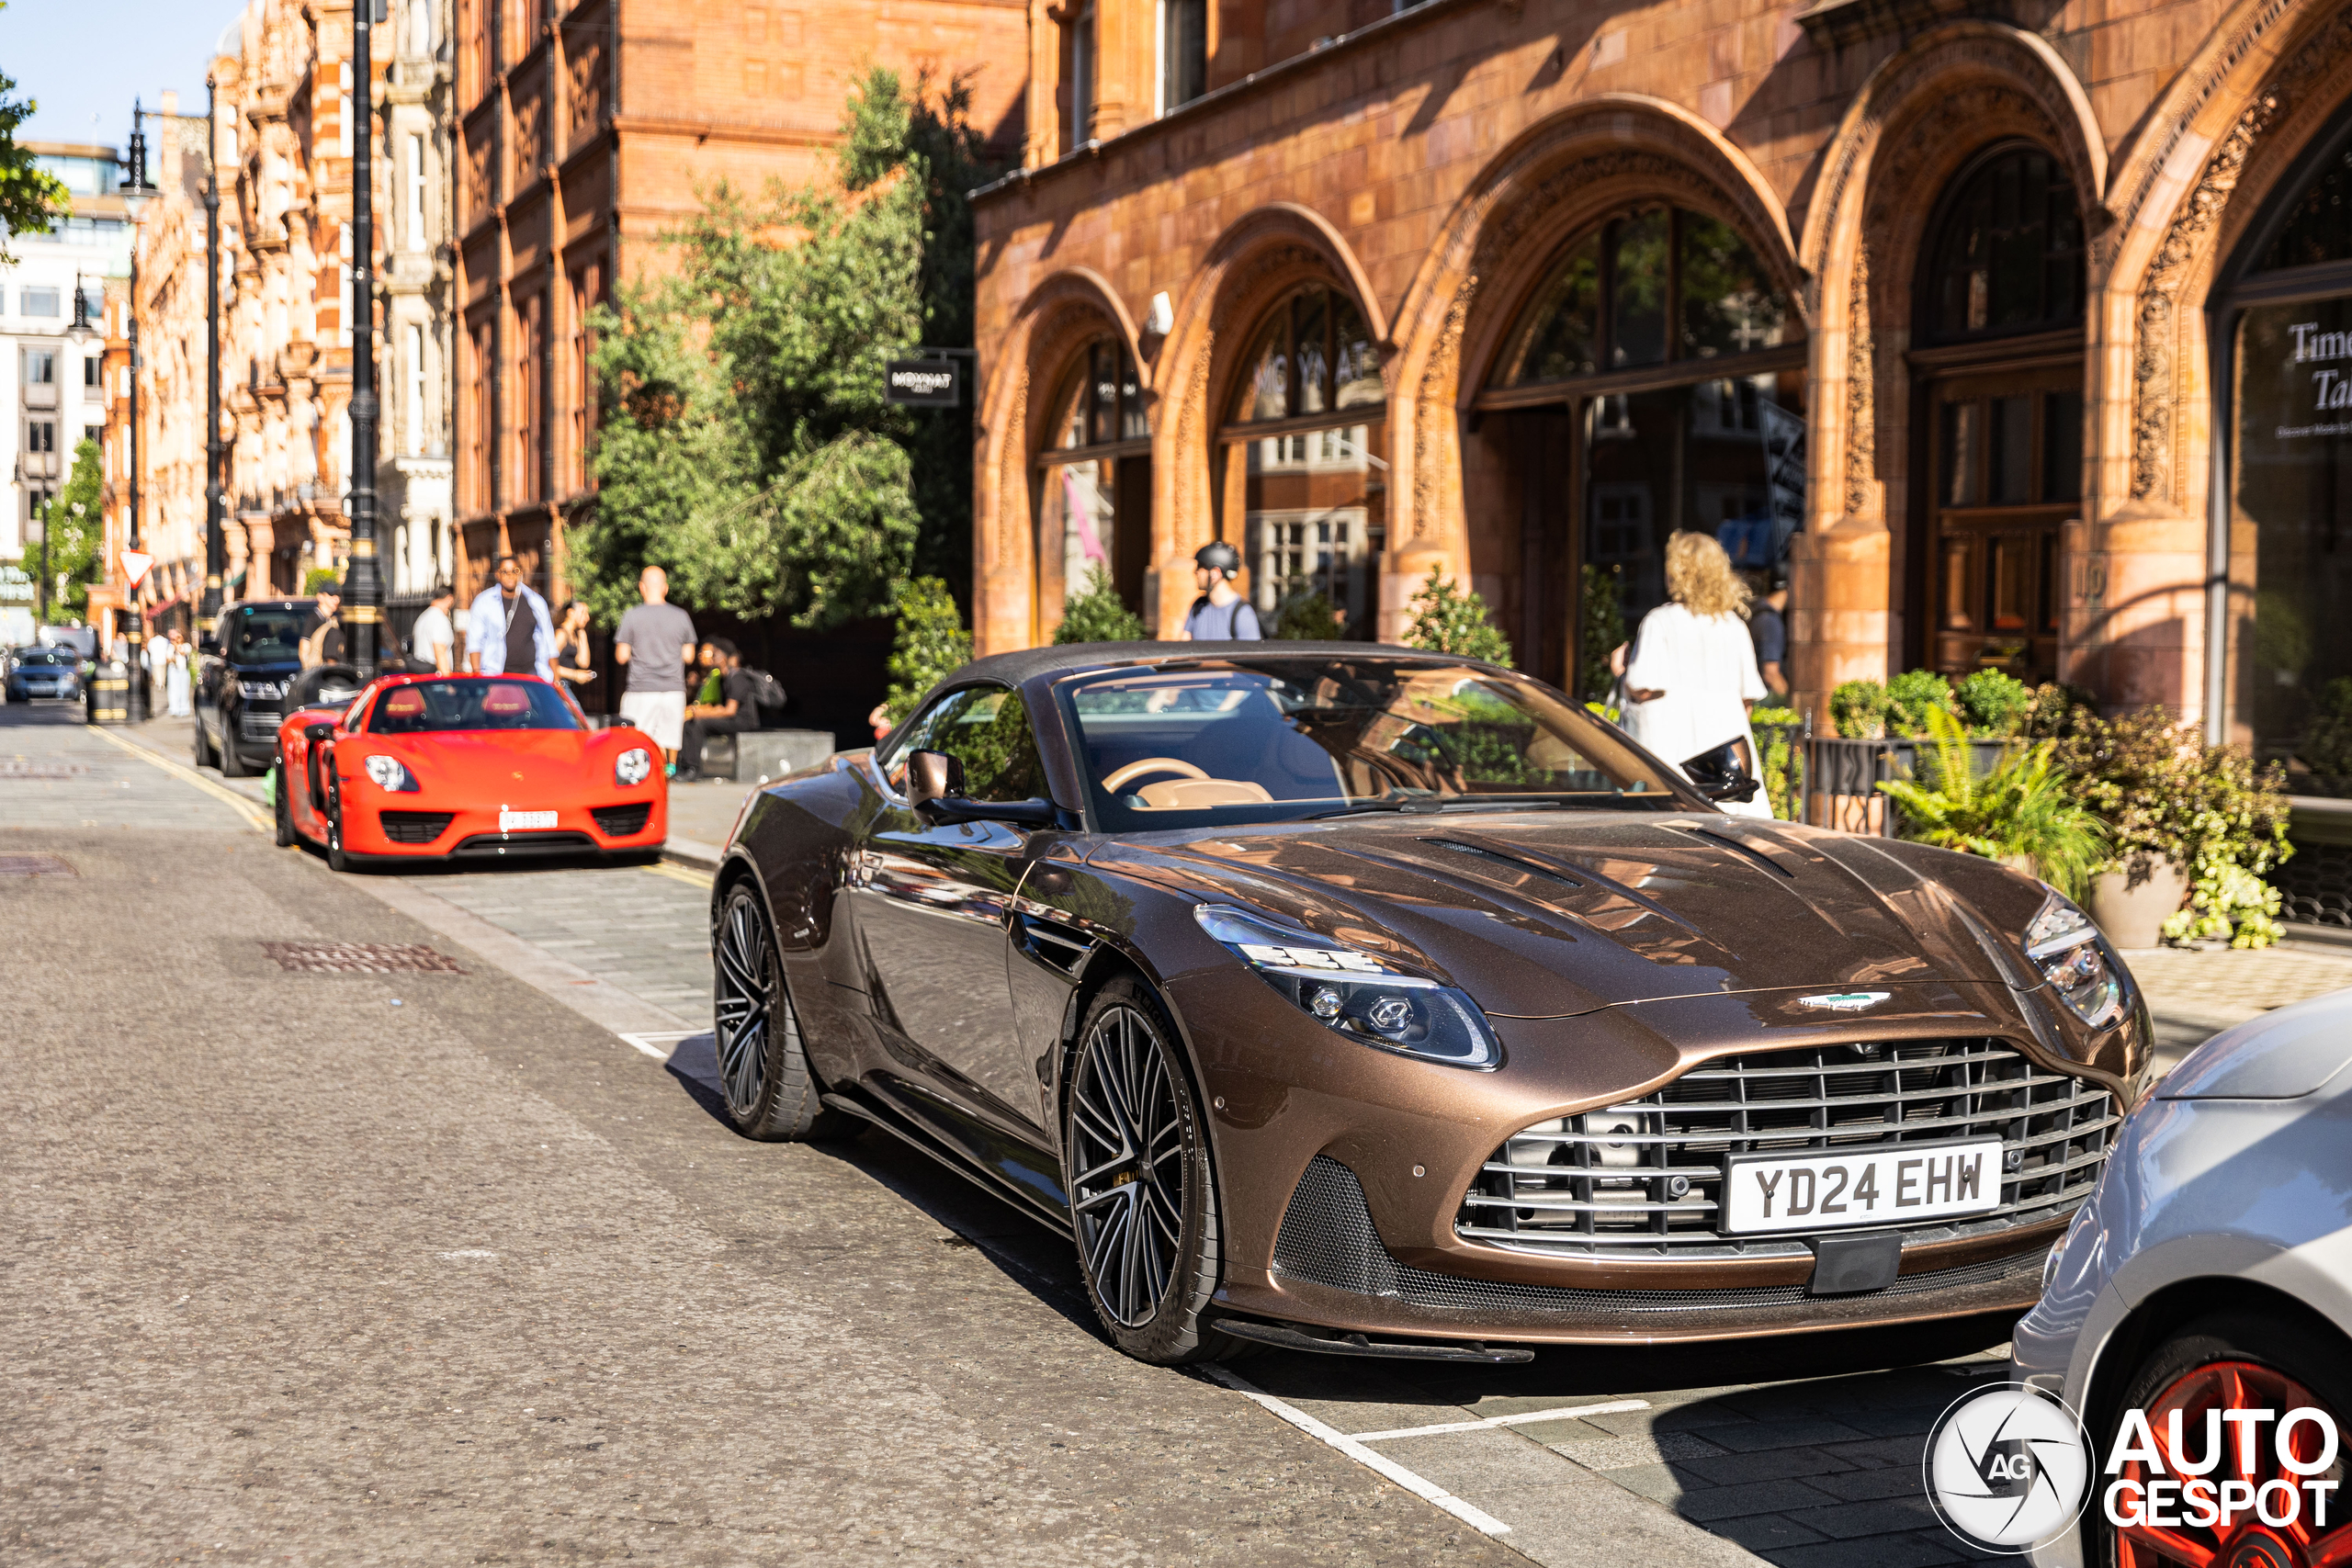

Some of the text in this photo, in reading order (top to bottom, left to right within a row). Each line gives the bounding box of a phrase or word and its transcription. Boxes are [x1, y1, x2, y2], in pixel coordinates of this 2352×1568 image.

[1142, 996, 1175, 1051] MICHE
[1756, 1153, 1983, 1218] YD24 EHW
